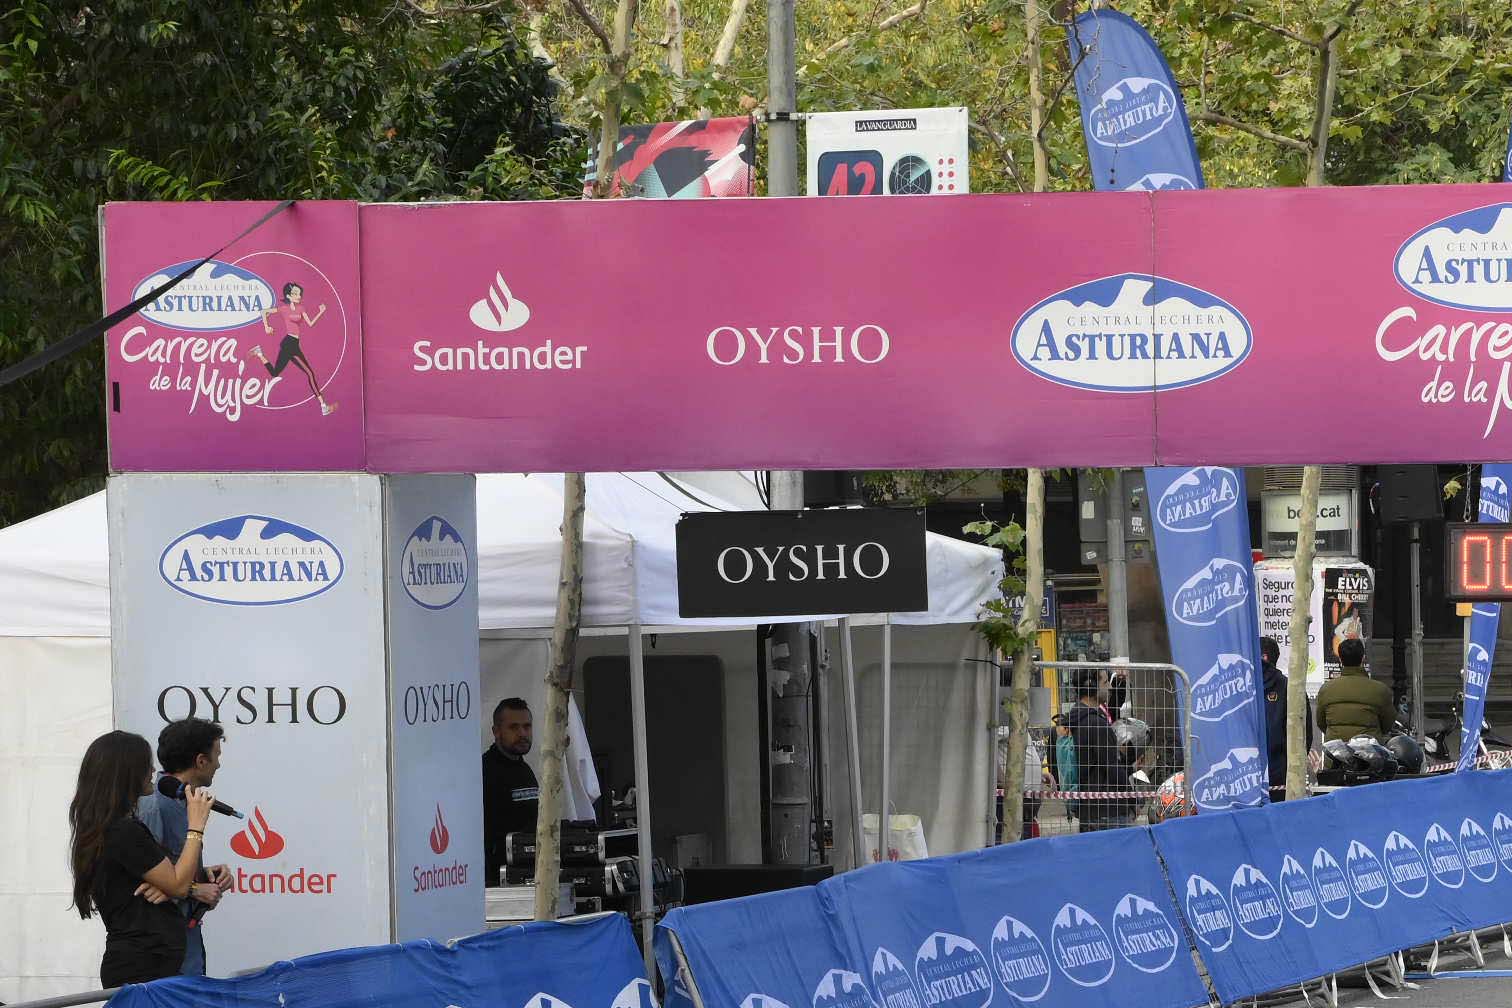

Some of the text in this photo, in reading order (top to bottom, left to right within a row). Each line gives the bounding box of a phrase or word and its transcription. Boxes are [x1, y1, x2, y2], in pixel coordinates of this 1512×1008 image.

[144, 286, 263, 312] ASTURIANA
[1067, 314, 1225, 327] CENTRAL LECHERA
[120, 326, 237, 363] Carrera
[413, 338, 587, 372] Santander
[706, 324, 890, 365] OYSHO
[1030, 318, 1234, 361] ASTURIANA
[150, 361, 282, 422] de la Mujer
[1421, 365, 1456, 404] de
[1463, 364, 1488, 404] la
[174, 549, 331, 582] ASTURIANA
[202, 547, 324, 555] CENTRAL LECHERA
[717, 542, 889, 583] OYSHO
[406, 551, 465, 586] ASTURIANA
[1338, 577, 1369, 590] ELVIS
[1264, 595, 1279, 606] que
[1265, 620, 1290, 631] mete
[157, 685, 346, 725] OYSHO
[404, 680, 470, 725] OYSHO
[230, 867, 336, 895] ntander
[413, 859, 469, 893] Santander
